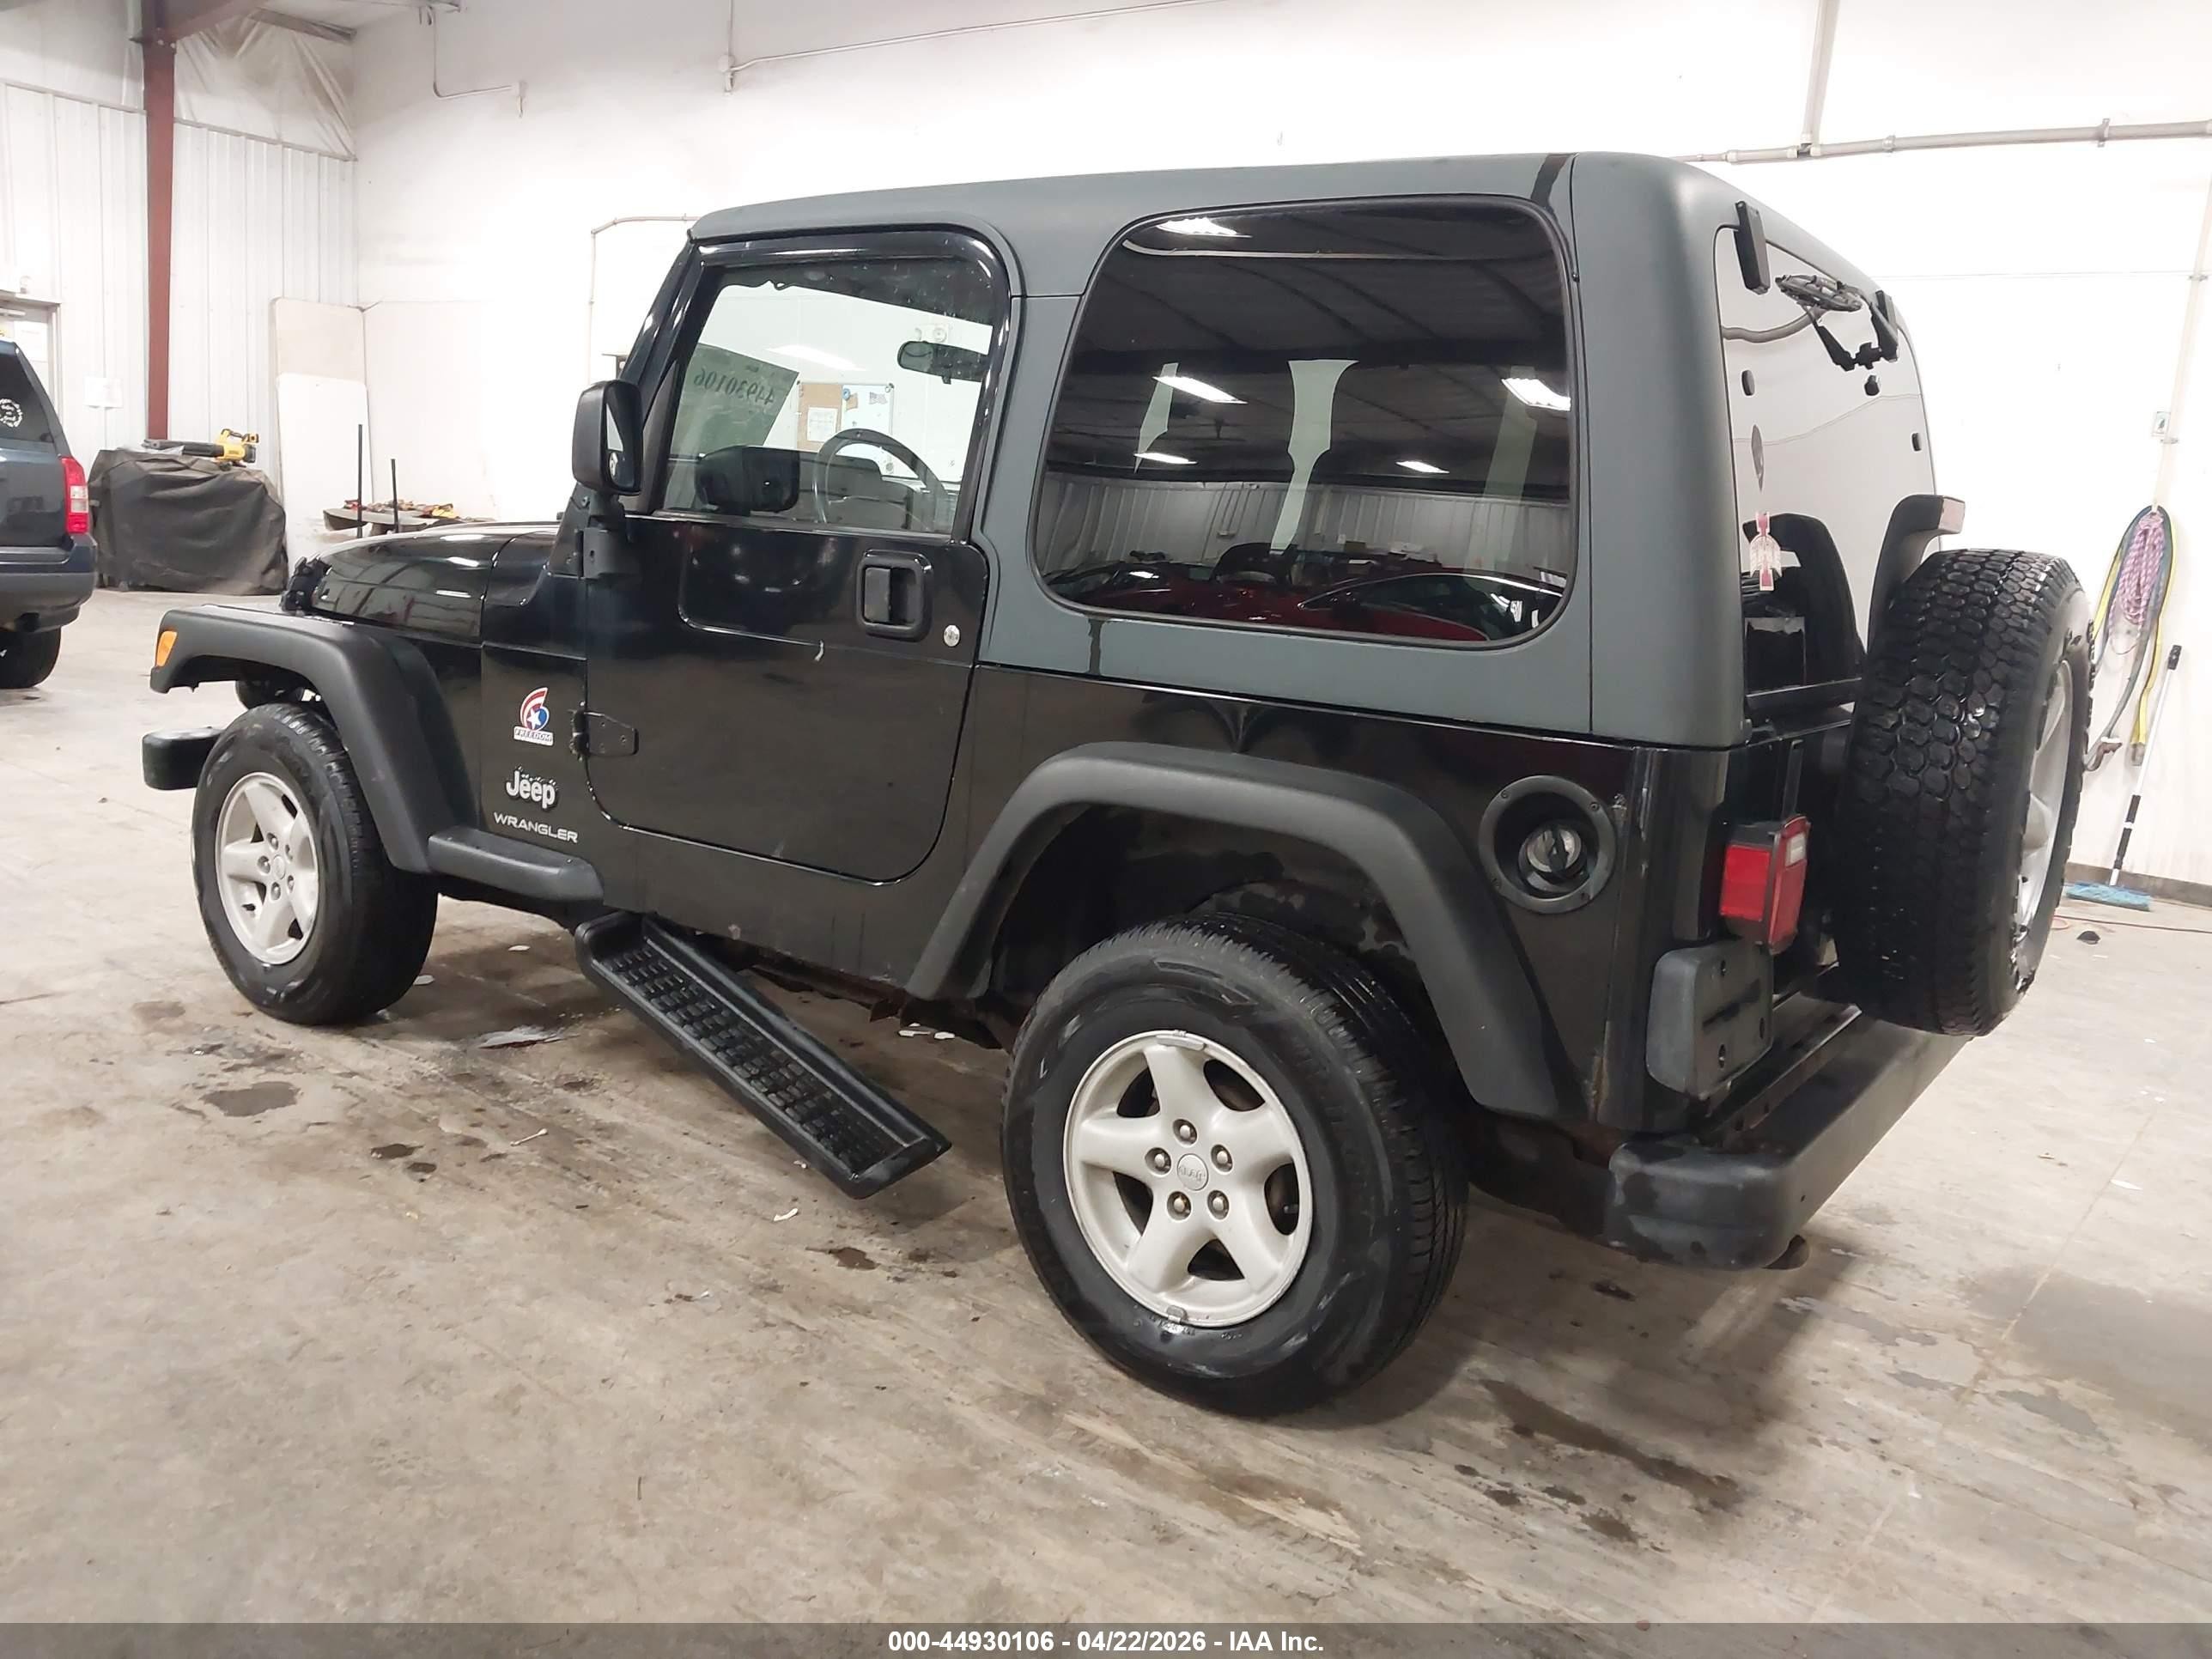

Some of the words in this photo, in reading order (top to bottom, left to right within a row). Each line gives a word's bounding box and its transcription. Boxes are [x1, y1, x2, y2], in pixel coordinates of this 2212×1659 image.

[515, 728, 553, 742] FREEDOM
[506, 770, 556, 809] Jeep
[494, 811, 579, 843] WRANGLER
